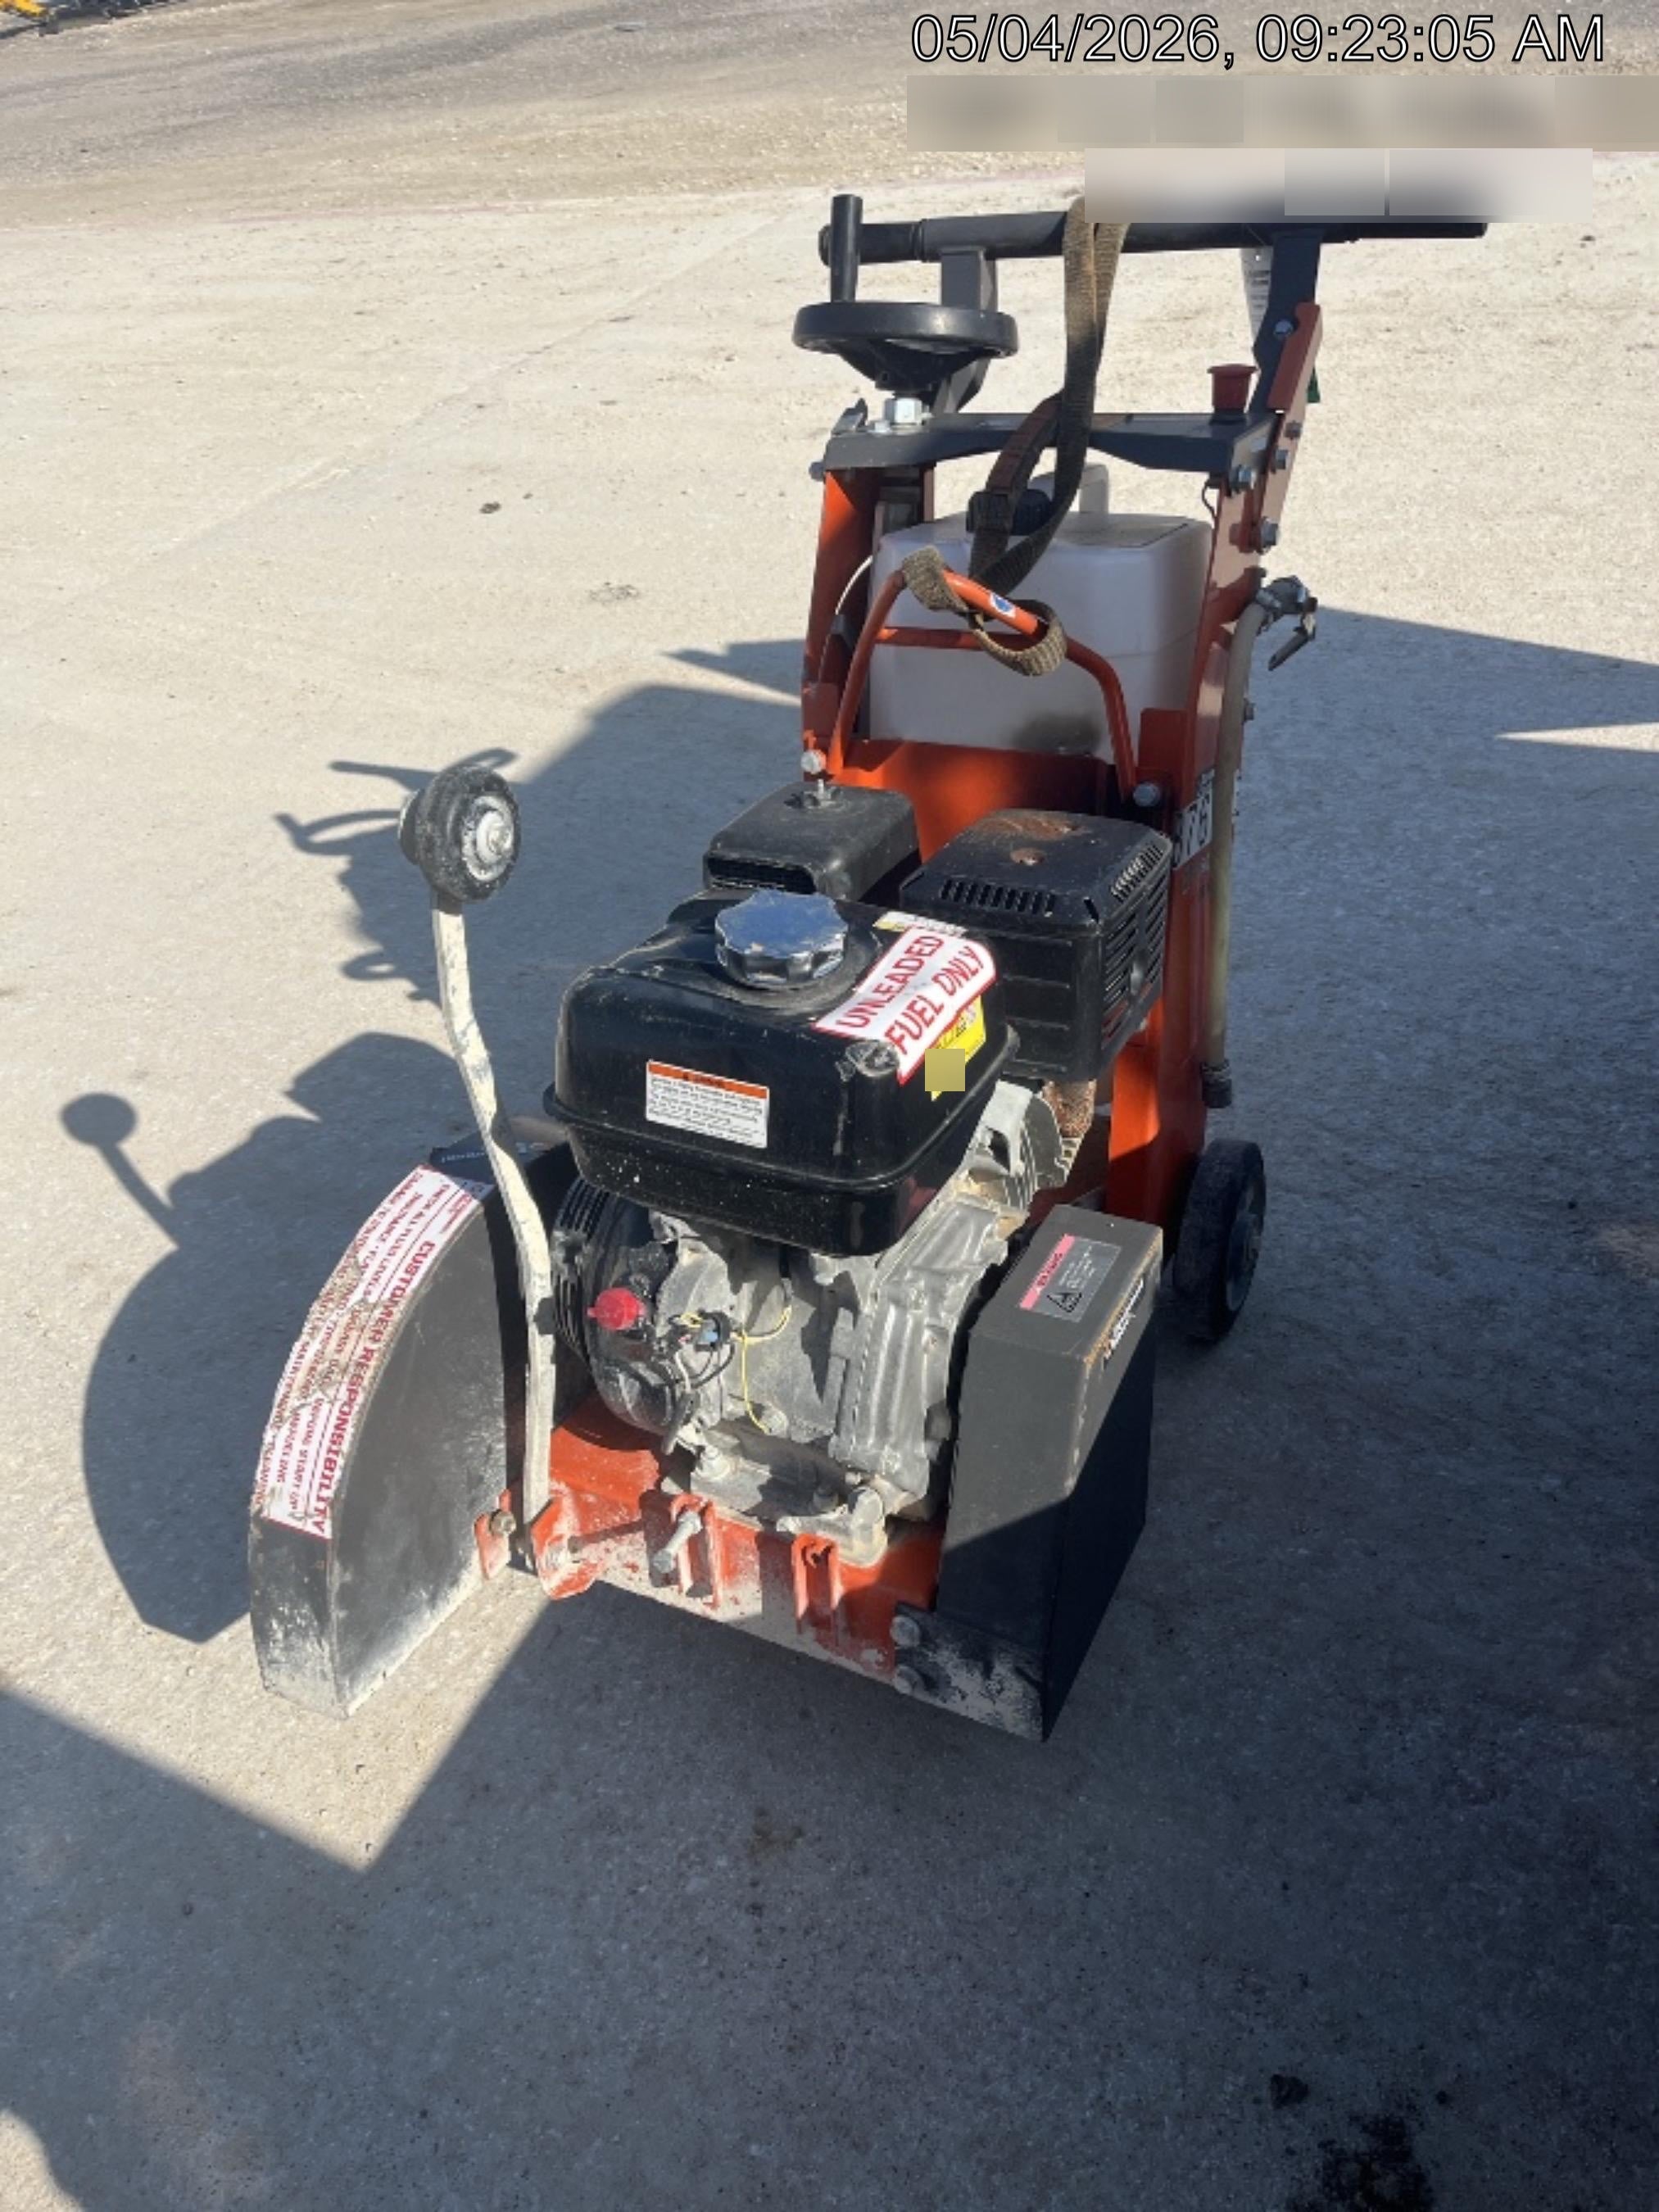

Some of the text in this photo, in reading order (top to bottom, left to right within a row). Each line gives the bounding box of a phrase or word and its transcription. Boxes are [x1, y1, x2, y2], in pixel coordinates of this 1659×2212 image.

[836, 935, 945, 1028] UNLEADED
[884, 995, 945, 1055] FUEL
[931, 945, 984, 996] ONLY
[407, 1211, 425, 1225] ALL
[367, 1240, 436, 1344] CUSTOMER
[292, 1449, 307, 1487] START
[312, 1346, 377, 1532] RESPONSIBILITY
